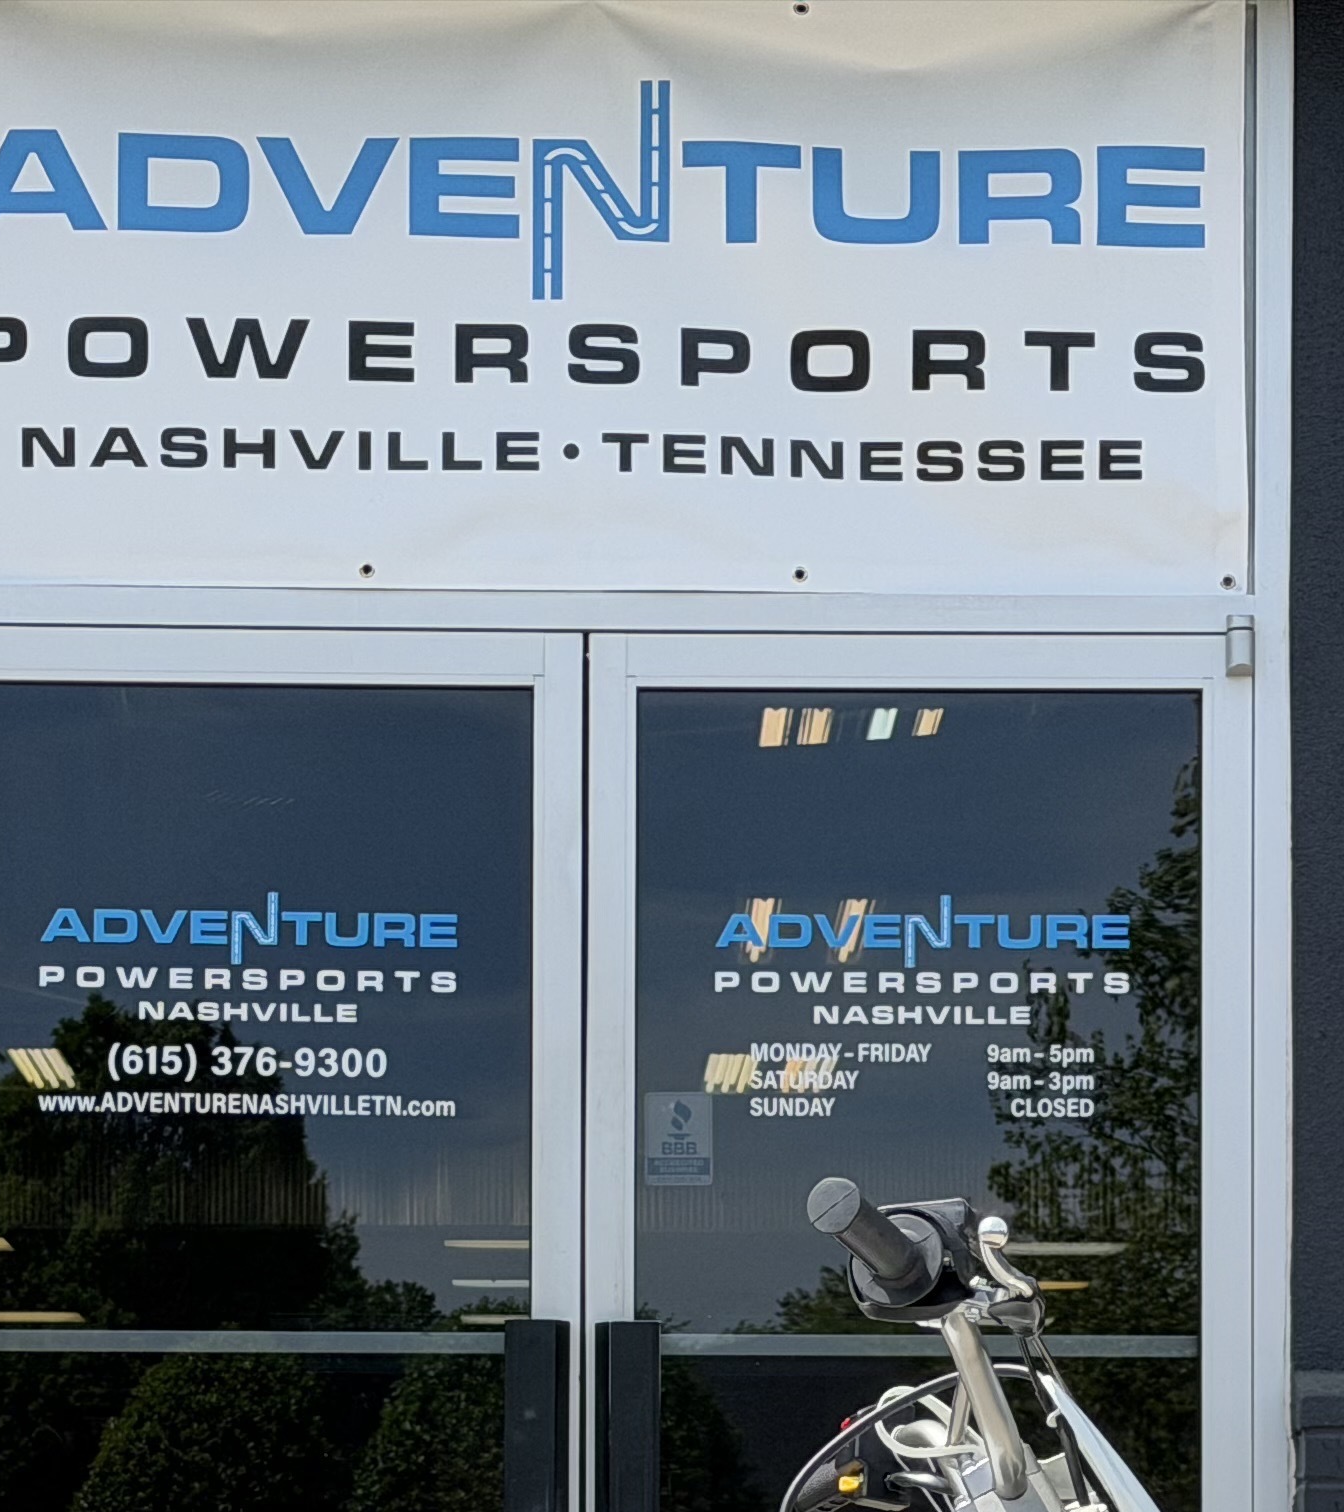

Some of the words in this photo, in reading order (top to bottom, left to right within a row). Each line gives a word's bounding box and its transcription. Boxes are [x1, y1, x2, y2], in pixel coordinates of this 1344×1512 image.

[21, 426, 540, 472] NASHVILLE
[602, 433, 1143, 482] TENNESSEE
[40, 892, 458, 965] ADVENTURE
[715, 895, 1130, 967] ADVENTURE
[39, 966, 457, 993] POWERSPORTS
[714, 971, 1130, 994] POWERSPORTS
[138, 1001, 358, 1022] NASHVILLE
[813, 1005, 1031, 1025] NASHVILLE
[107, 1042, 198, 1082] (615)
[211, 1046, 387, 1079] 376-9300
[749, 1070, 859, 1090] SATURDAY
[38, 1092, 456, 1117] www.ADVENTURENASHVILLETN.com
[749, 1097, 836, 1117] SUNDAY
[1010, 1098, 1095, 1118] CLOSED
[661, 1141, 698, 1156] BBB
